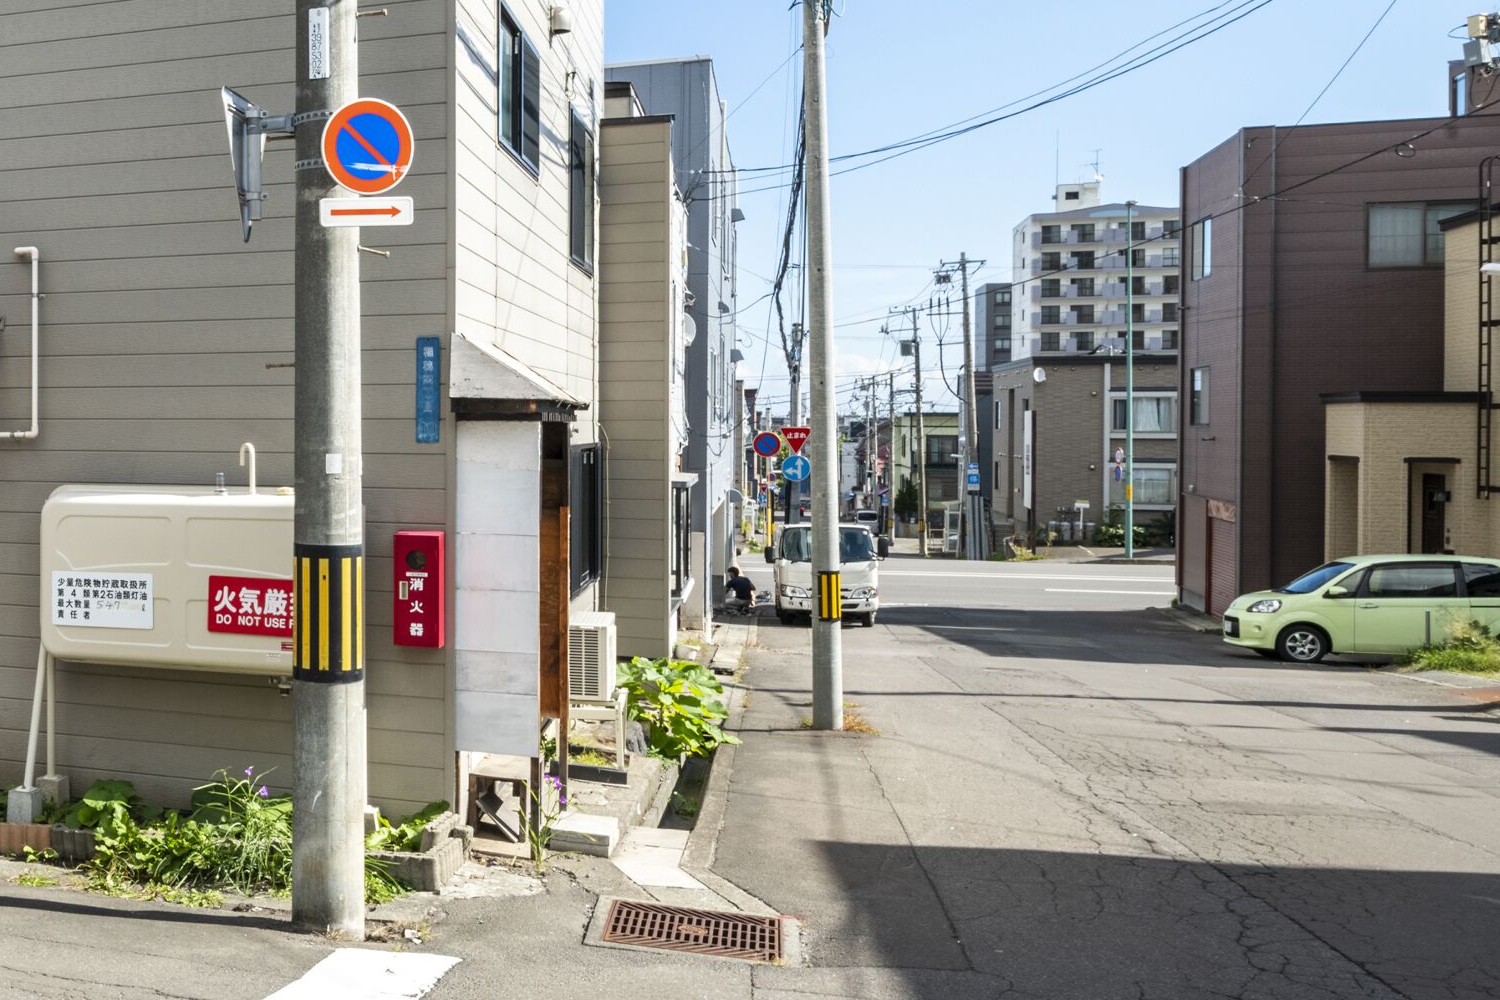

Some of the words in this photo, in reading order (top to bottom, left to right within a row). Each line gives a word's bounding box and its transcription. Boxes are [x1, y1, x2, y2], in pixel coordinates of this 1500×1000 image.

[57, 578, 148, 590] 少量危険物貯蔵取扱所
[57, 599, 91, 609] 最大数量
[213, 586, 294, 617] 火気厳
[409, 578, 424, 637] 消火器
[57, 609, 90, 620] 責任者
[216, 614, 232, 625] DO
[237, 615, 261, 627] NOT
[264, 617, 286, 629] USE
